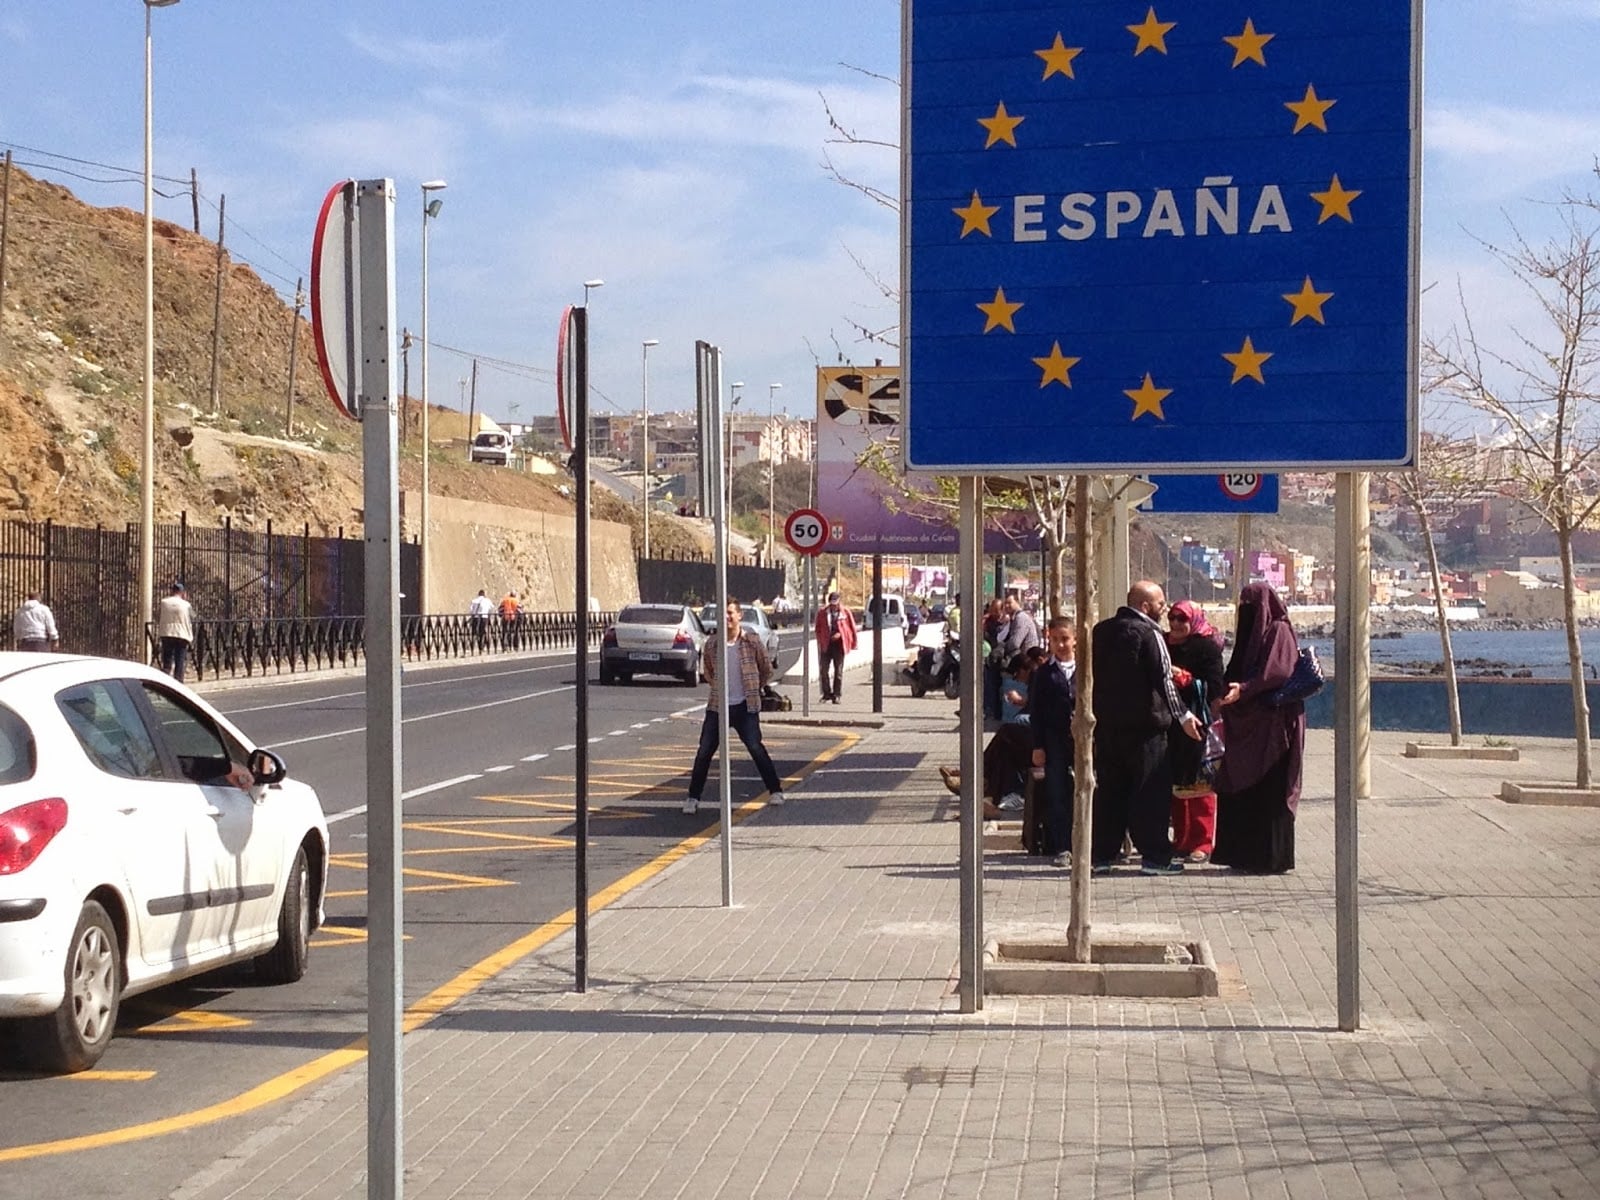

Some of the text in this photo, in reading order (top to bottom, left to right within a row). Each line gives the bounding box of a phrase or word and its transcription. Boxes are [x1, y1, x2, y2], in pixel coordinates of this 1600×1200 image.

[1014, 176, 1292, 242] ESPAÑA
[1227, 474, 1255, 485] 120
[795, 524, 819, 538] 50
